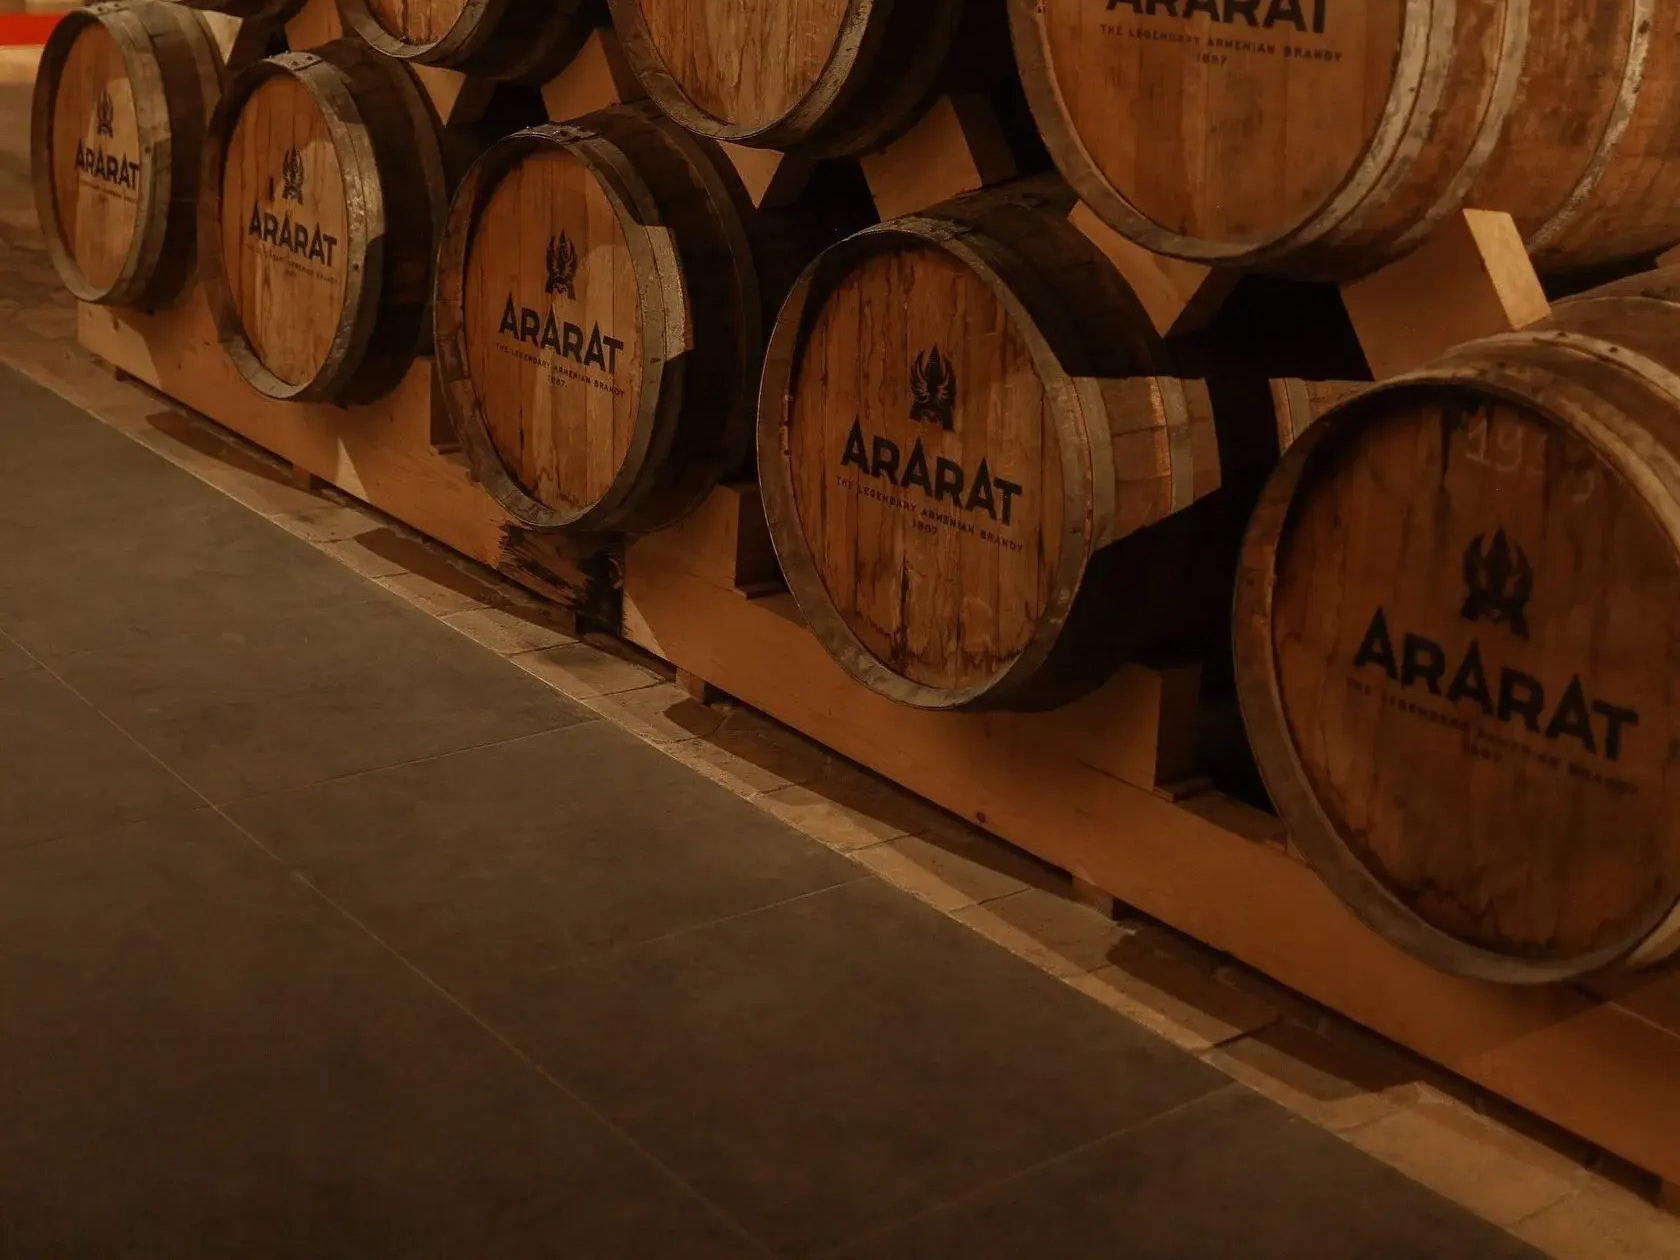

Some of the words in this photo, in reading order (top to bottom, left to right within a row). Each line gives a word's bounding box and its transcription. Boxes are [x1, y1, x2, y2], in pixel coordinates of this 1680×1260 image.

[1101, 24, 1122, 36] THE
[74, 137, 139, 191] ARARAT
[248, 199, 338, 268] ARARAT
[498, 291, 625, 375] ARARAT
[841, 414, 1023, 526] ARARAT
[836, 475, 853, 490] THE
[856, 487, 917, 512] LEGENDARY
[921, 506, 975, 535] ARMENIAN
[980, 529, 1024, 553] BRANDY
[1352, 604, 1640, 762] ARARAT
